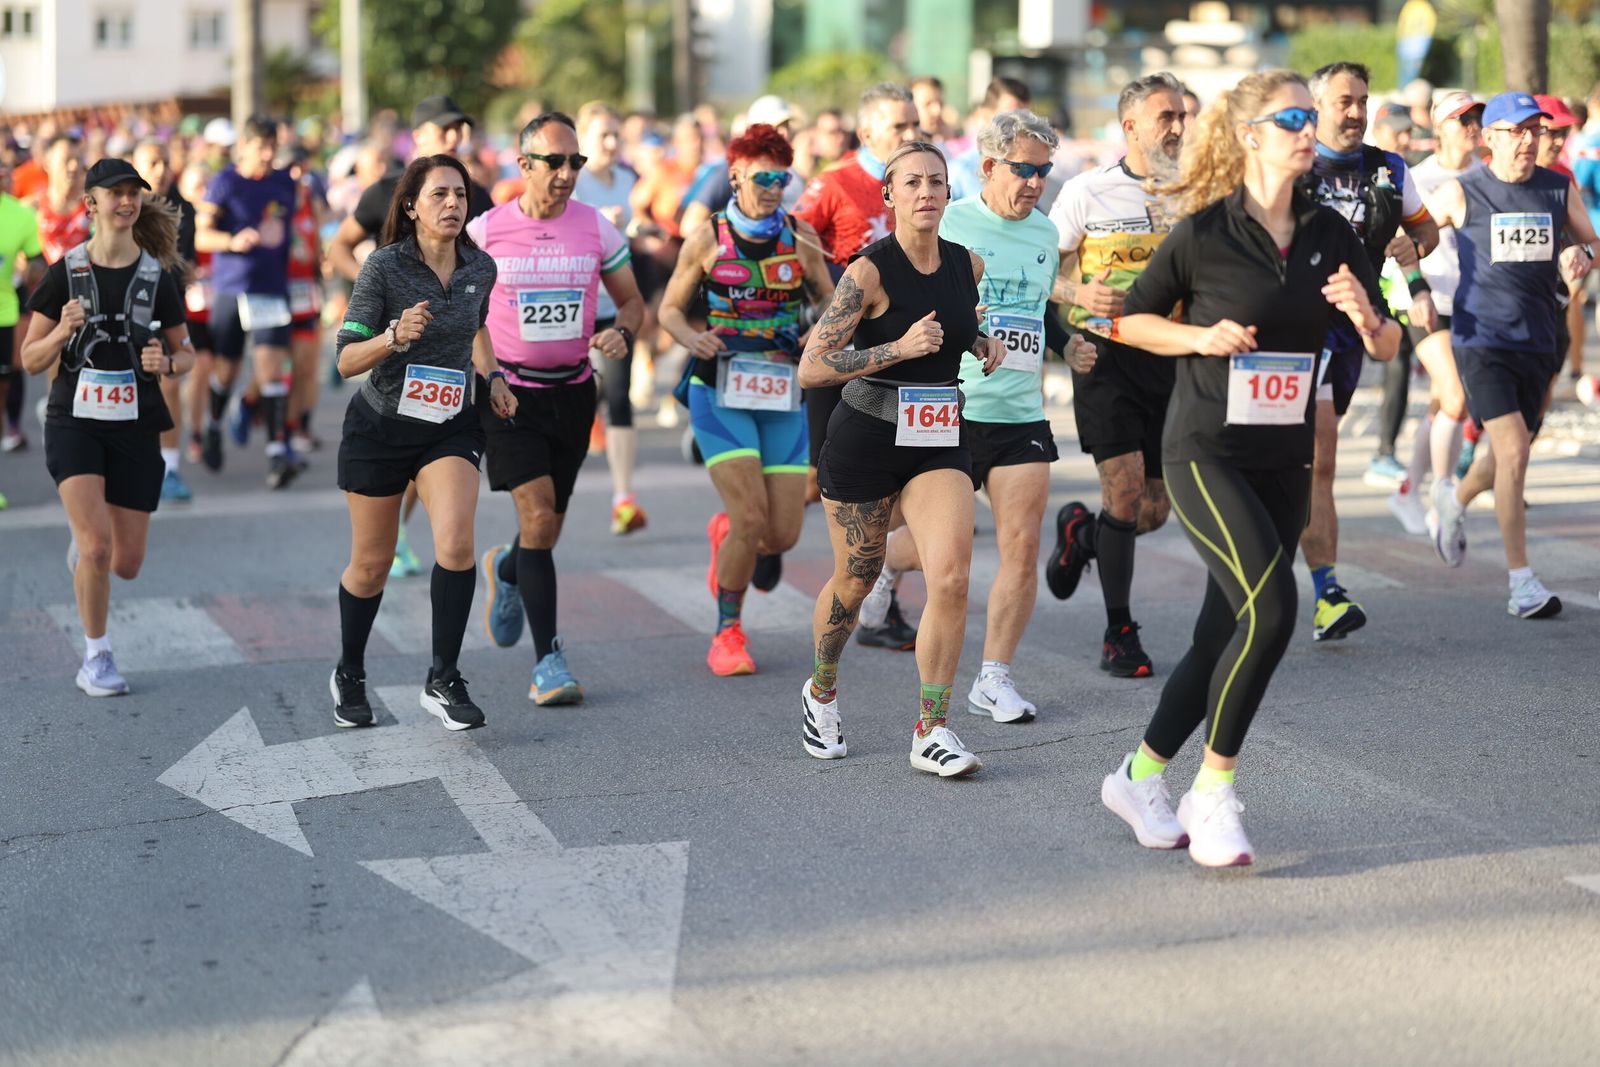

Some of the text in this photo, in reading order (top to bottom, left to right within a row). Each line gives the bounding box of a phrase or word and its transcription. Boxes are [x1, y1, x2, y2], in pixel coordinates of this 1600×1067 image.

[1498, 228, 1549, 245] 1425
[523, 303, 580, 325] 2237
[81, 384, 135, 404] 1143
[406, 379, 462, 408] 2368
[733, 373, 788, 396] 1433
[1248, 374, 1299, 402] 105
[903, 404, 960, 428] 1642
